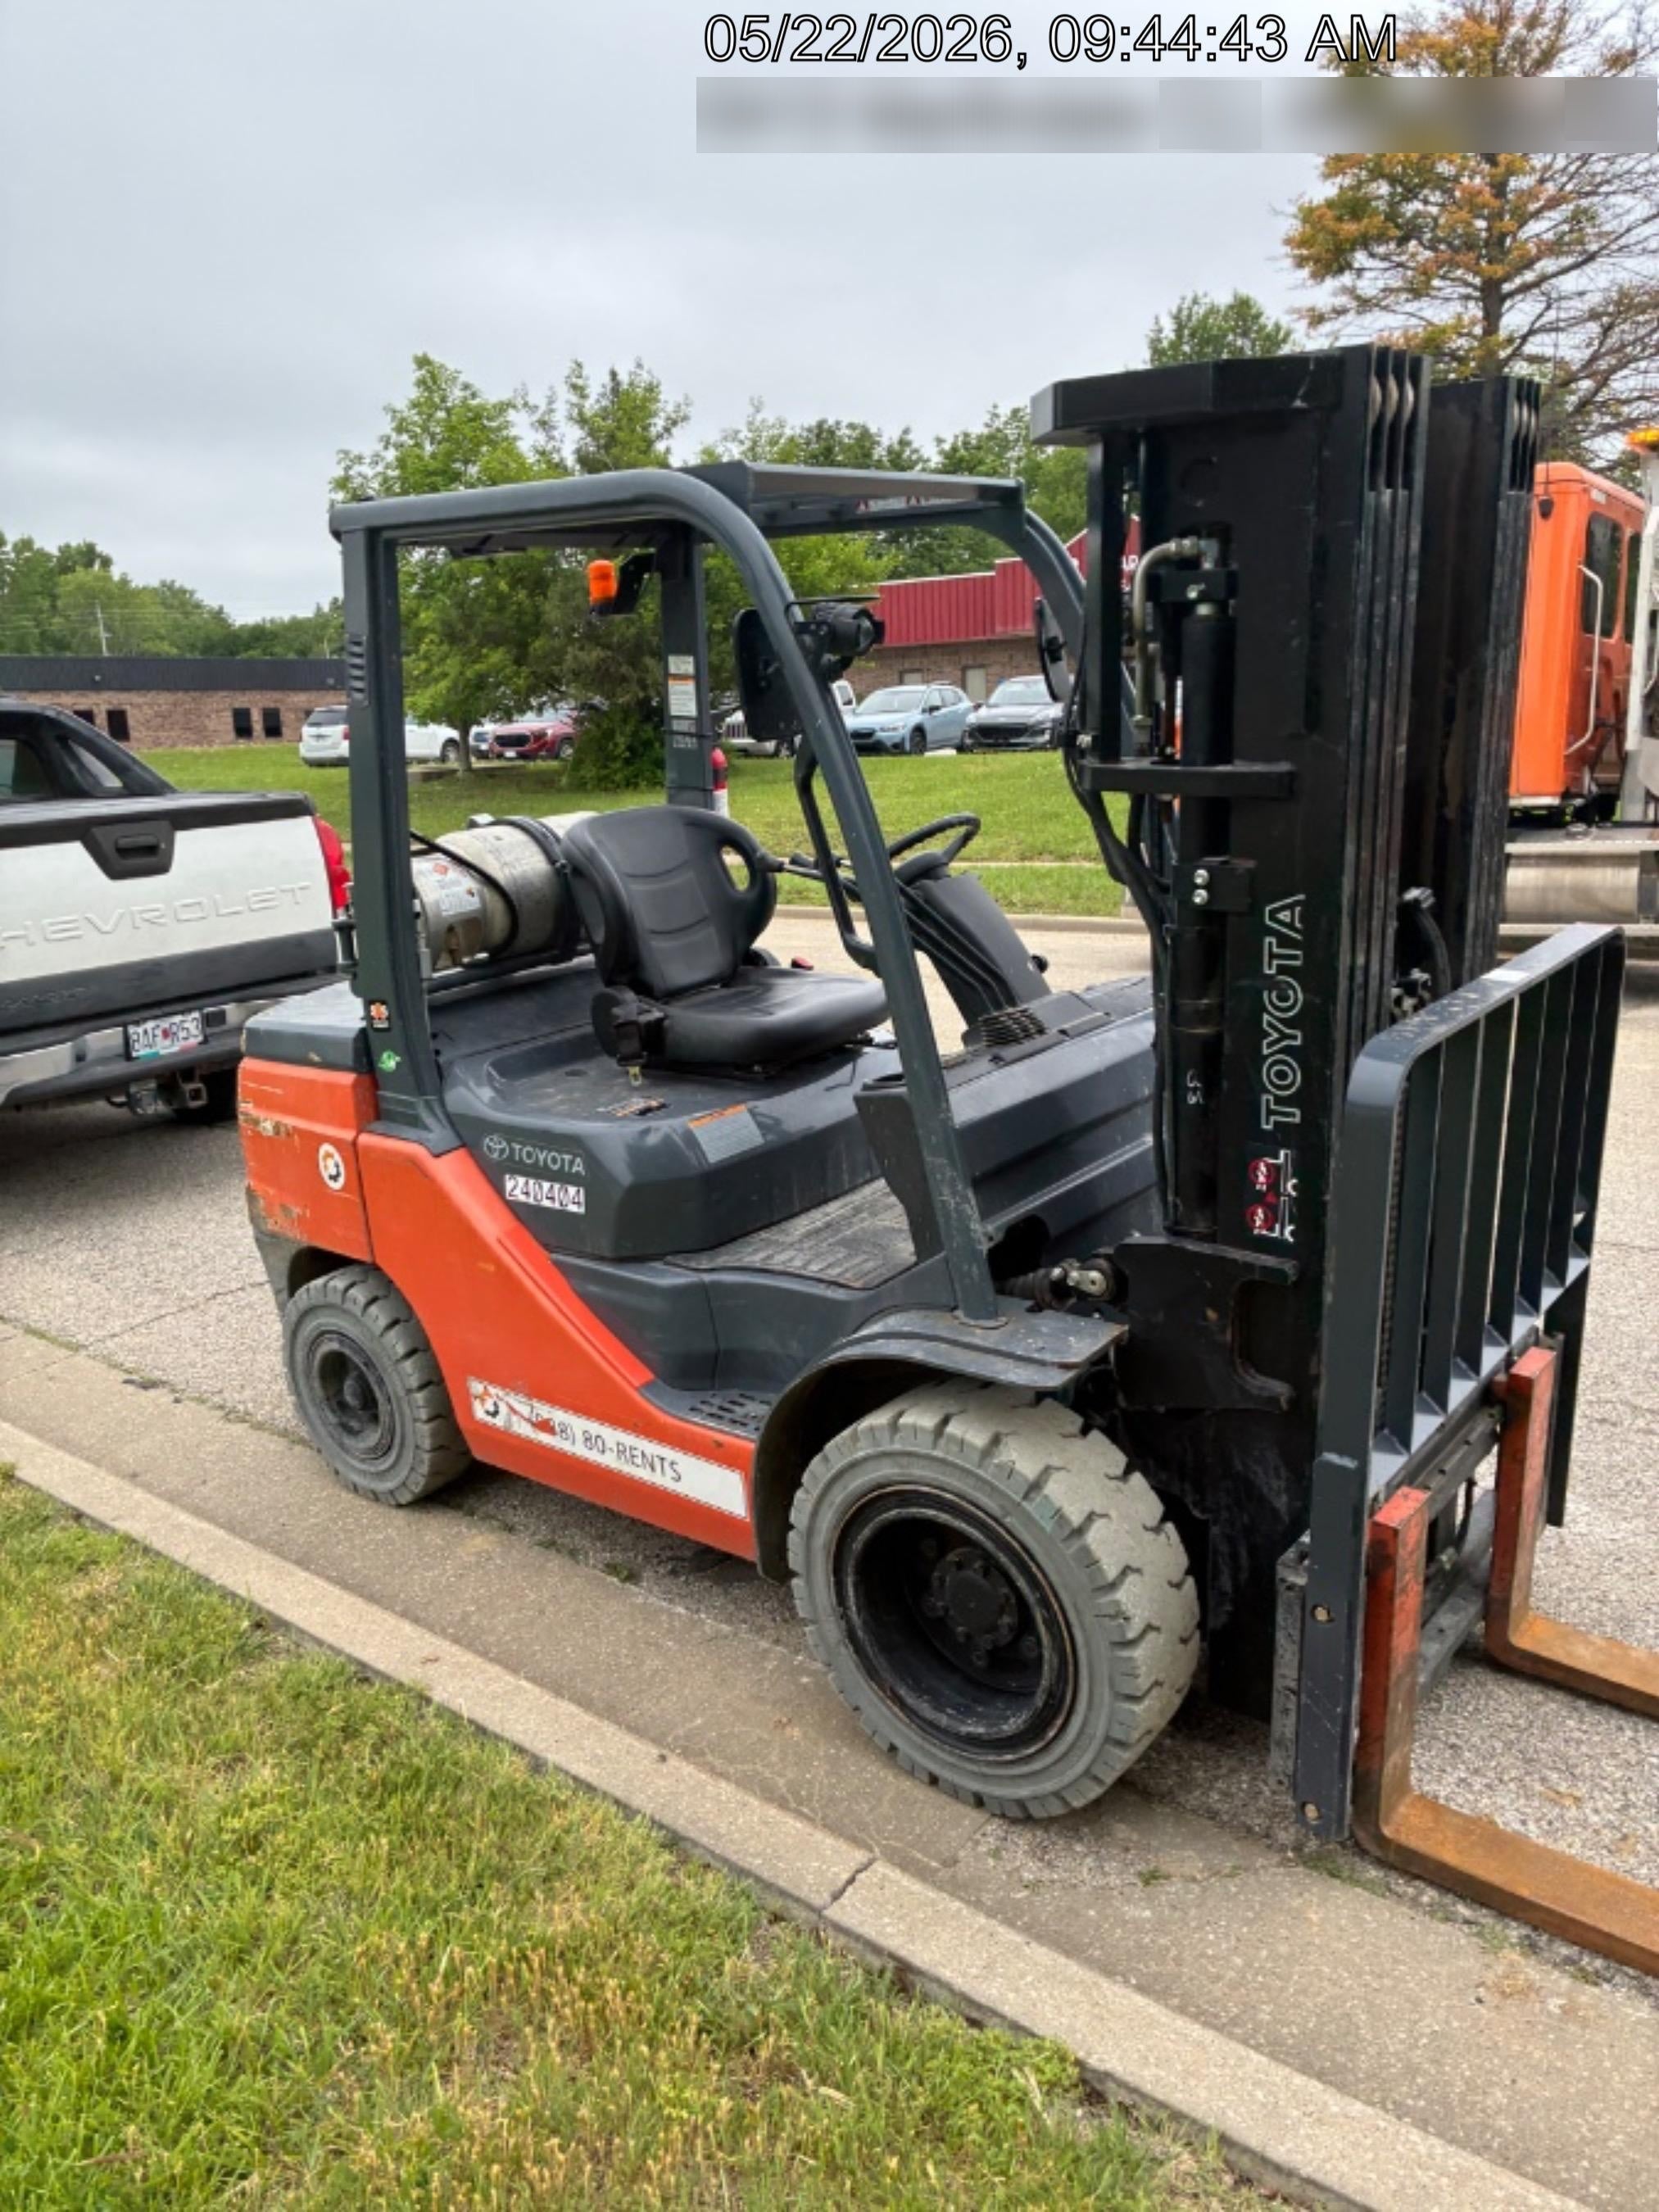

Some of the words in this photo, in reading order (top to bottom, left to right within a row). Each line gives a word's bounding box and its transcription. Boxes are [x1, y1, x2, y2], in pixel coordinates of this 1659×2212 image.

[1260, 893, 1307, 1131] TOYOTA
[510, 1142, 586, 1176] TOYOTA
[507, 1175, 583, 1210] 240404
[581, 1430, 682, 1484] 80-RENTS
